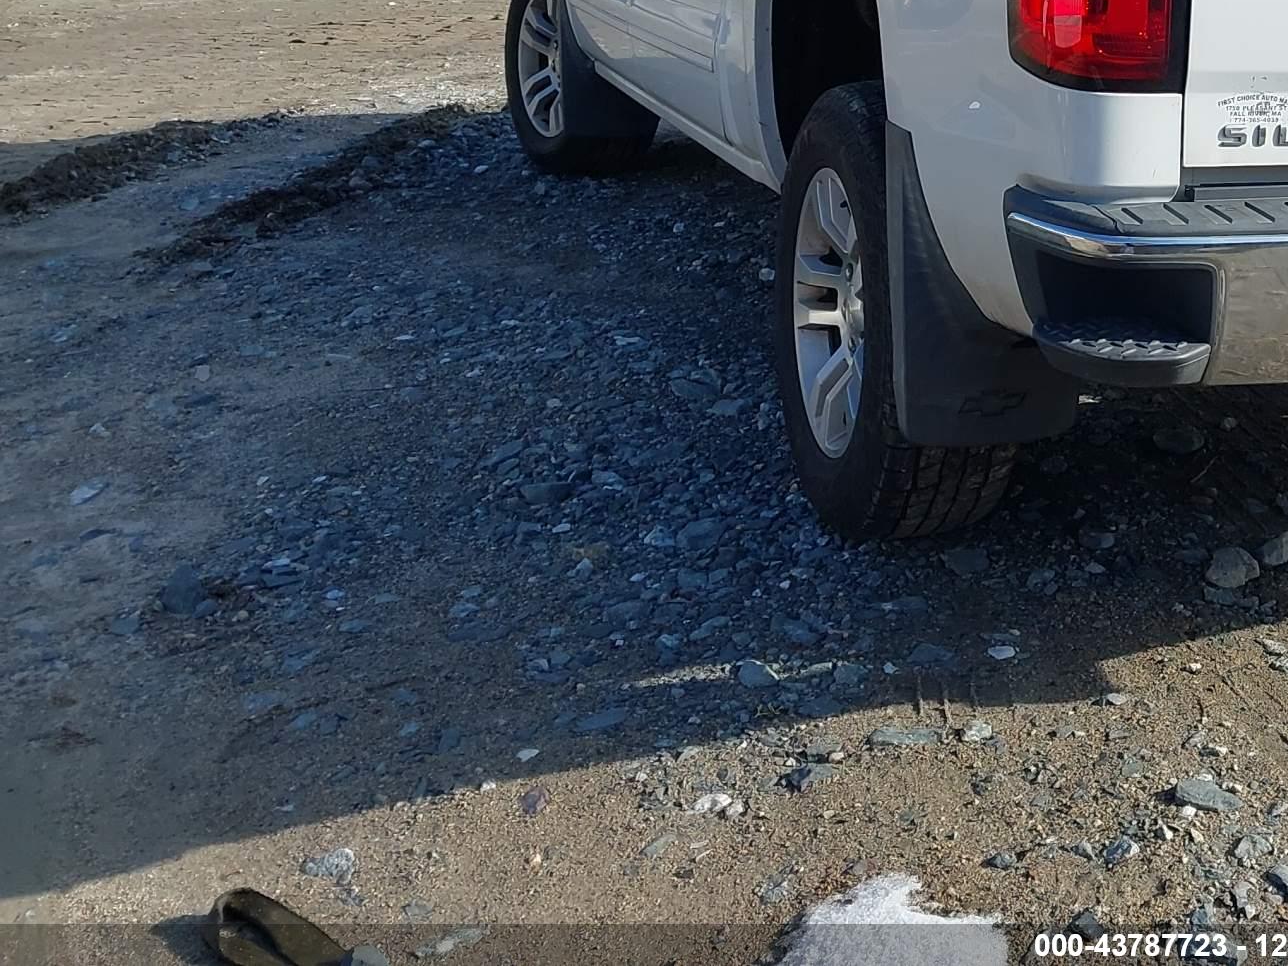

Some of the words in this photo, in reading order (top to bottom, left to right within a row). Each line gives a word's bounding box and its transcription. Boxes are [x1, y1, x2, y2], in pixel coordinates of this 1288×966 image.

[1217, 97, 1235, 106] FIRST
[1236, 94, 1260, 102] CHOICE
[1261, 94, 1278, 102] AUTO
